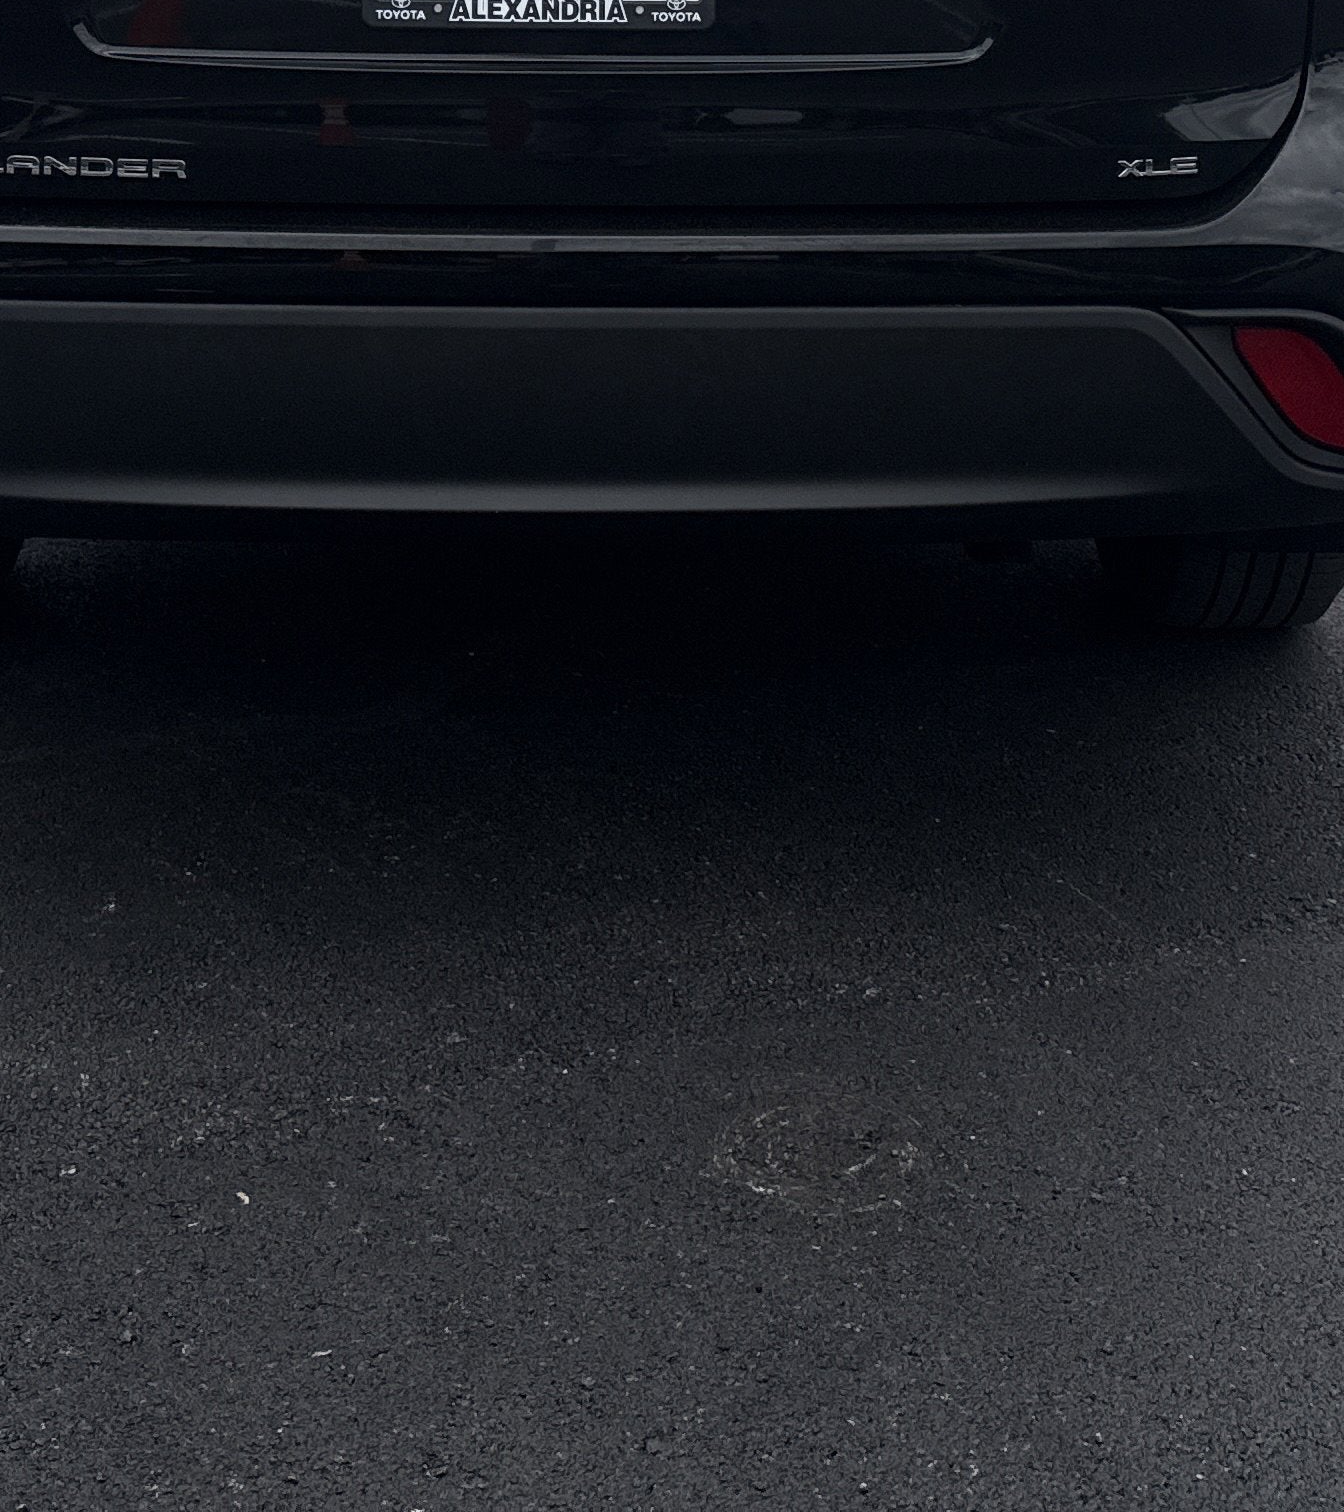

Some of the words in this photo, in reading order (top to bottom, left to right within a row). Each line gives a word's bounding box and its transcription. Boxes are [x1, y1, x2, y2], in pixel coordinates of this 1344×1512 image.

[375, 9, 426, 20] TOYOTA
[651, 11, 701, 23] TOYOTA
[1118, 156, 1198, 177] XLE
